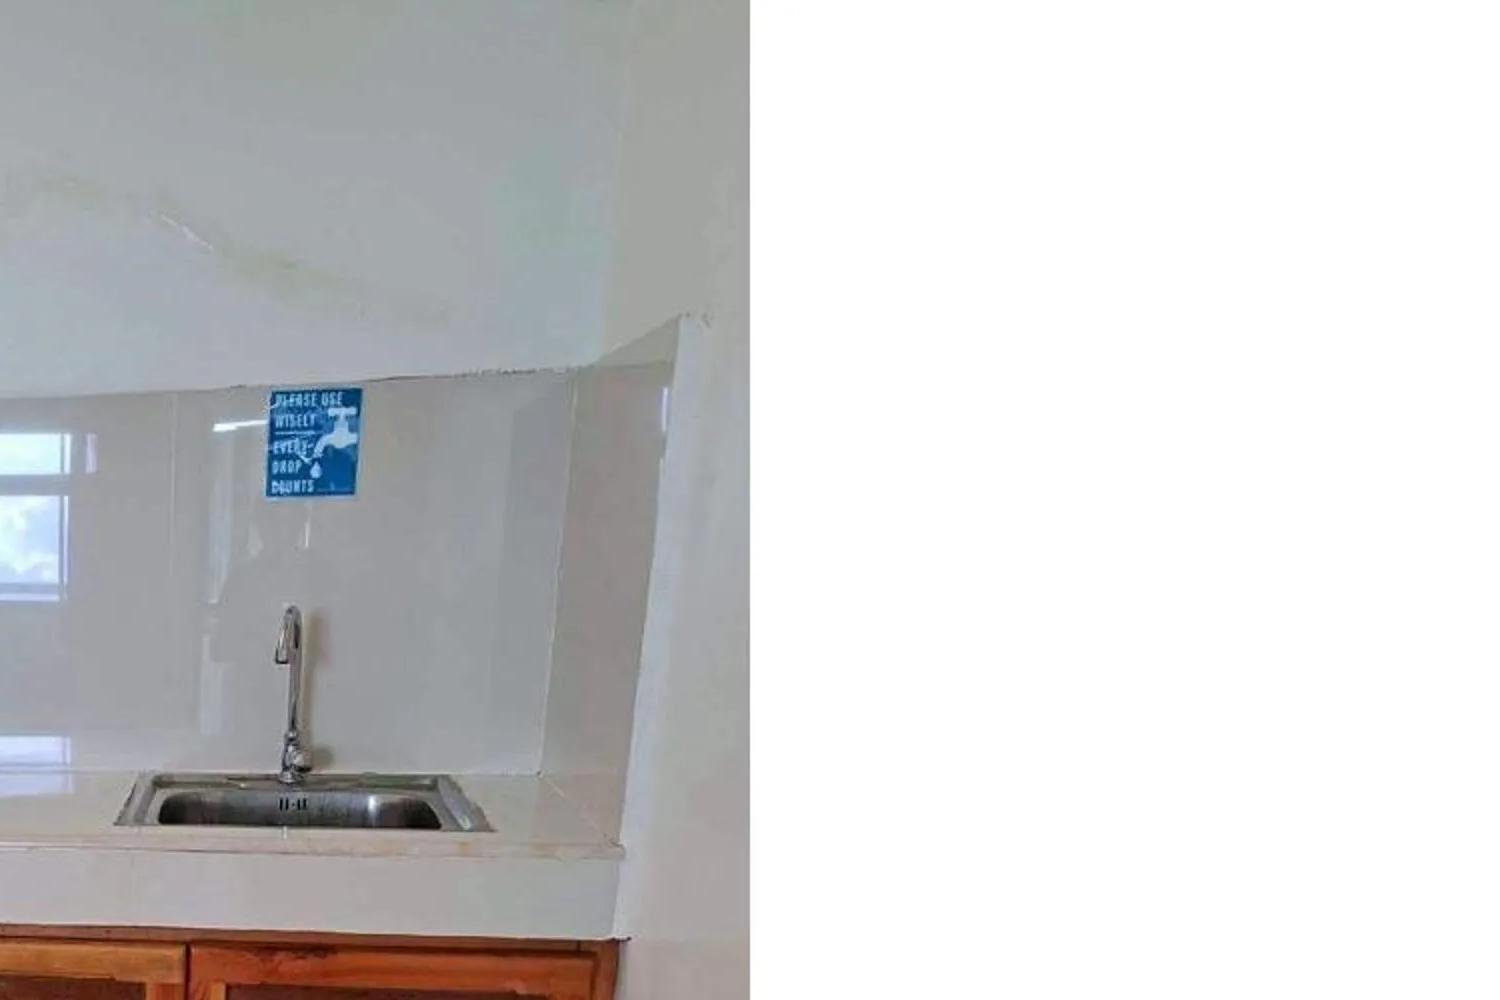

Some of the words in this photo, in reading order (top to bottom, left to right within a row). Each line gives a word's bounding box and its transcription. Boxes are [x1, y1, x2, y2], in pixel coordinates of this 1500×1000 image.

[321, 391, 344, 406] USE
[275, 413, 316, 428] WISELY
[271, 460, 302, 475] DROP
